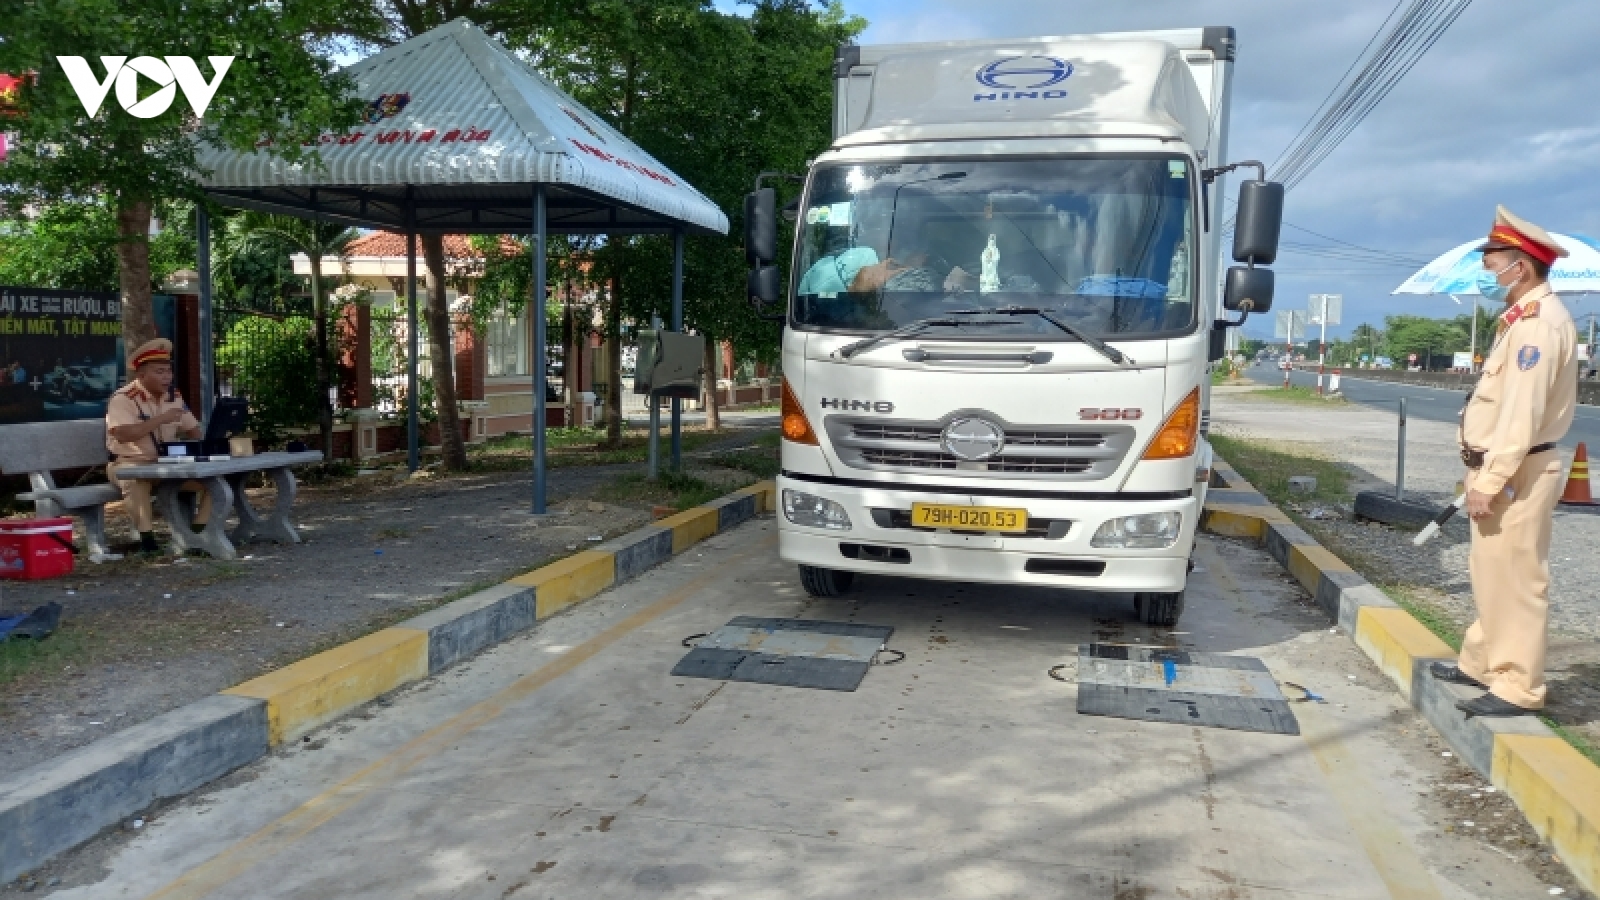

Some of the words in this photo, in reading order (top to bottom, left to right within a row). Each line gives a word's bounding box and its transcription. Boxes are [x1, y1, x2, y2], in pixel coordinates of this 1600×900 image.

[973, 89, 1068, 102] HINO
[20, 295, 39, 313] XE
[820, 396, 896, 414] HINO
[1077, 407, 1143, 420] 500
[921, 507, 1017, 527] 79H-020.53
